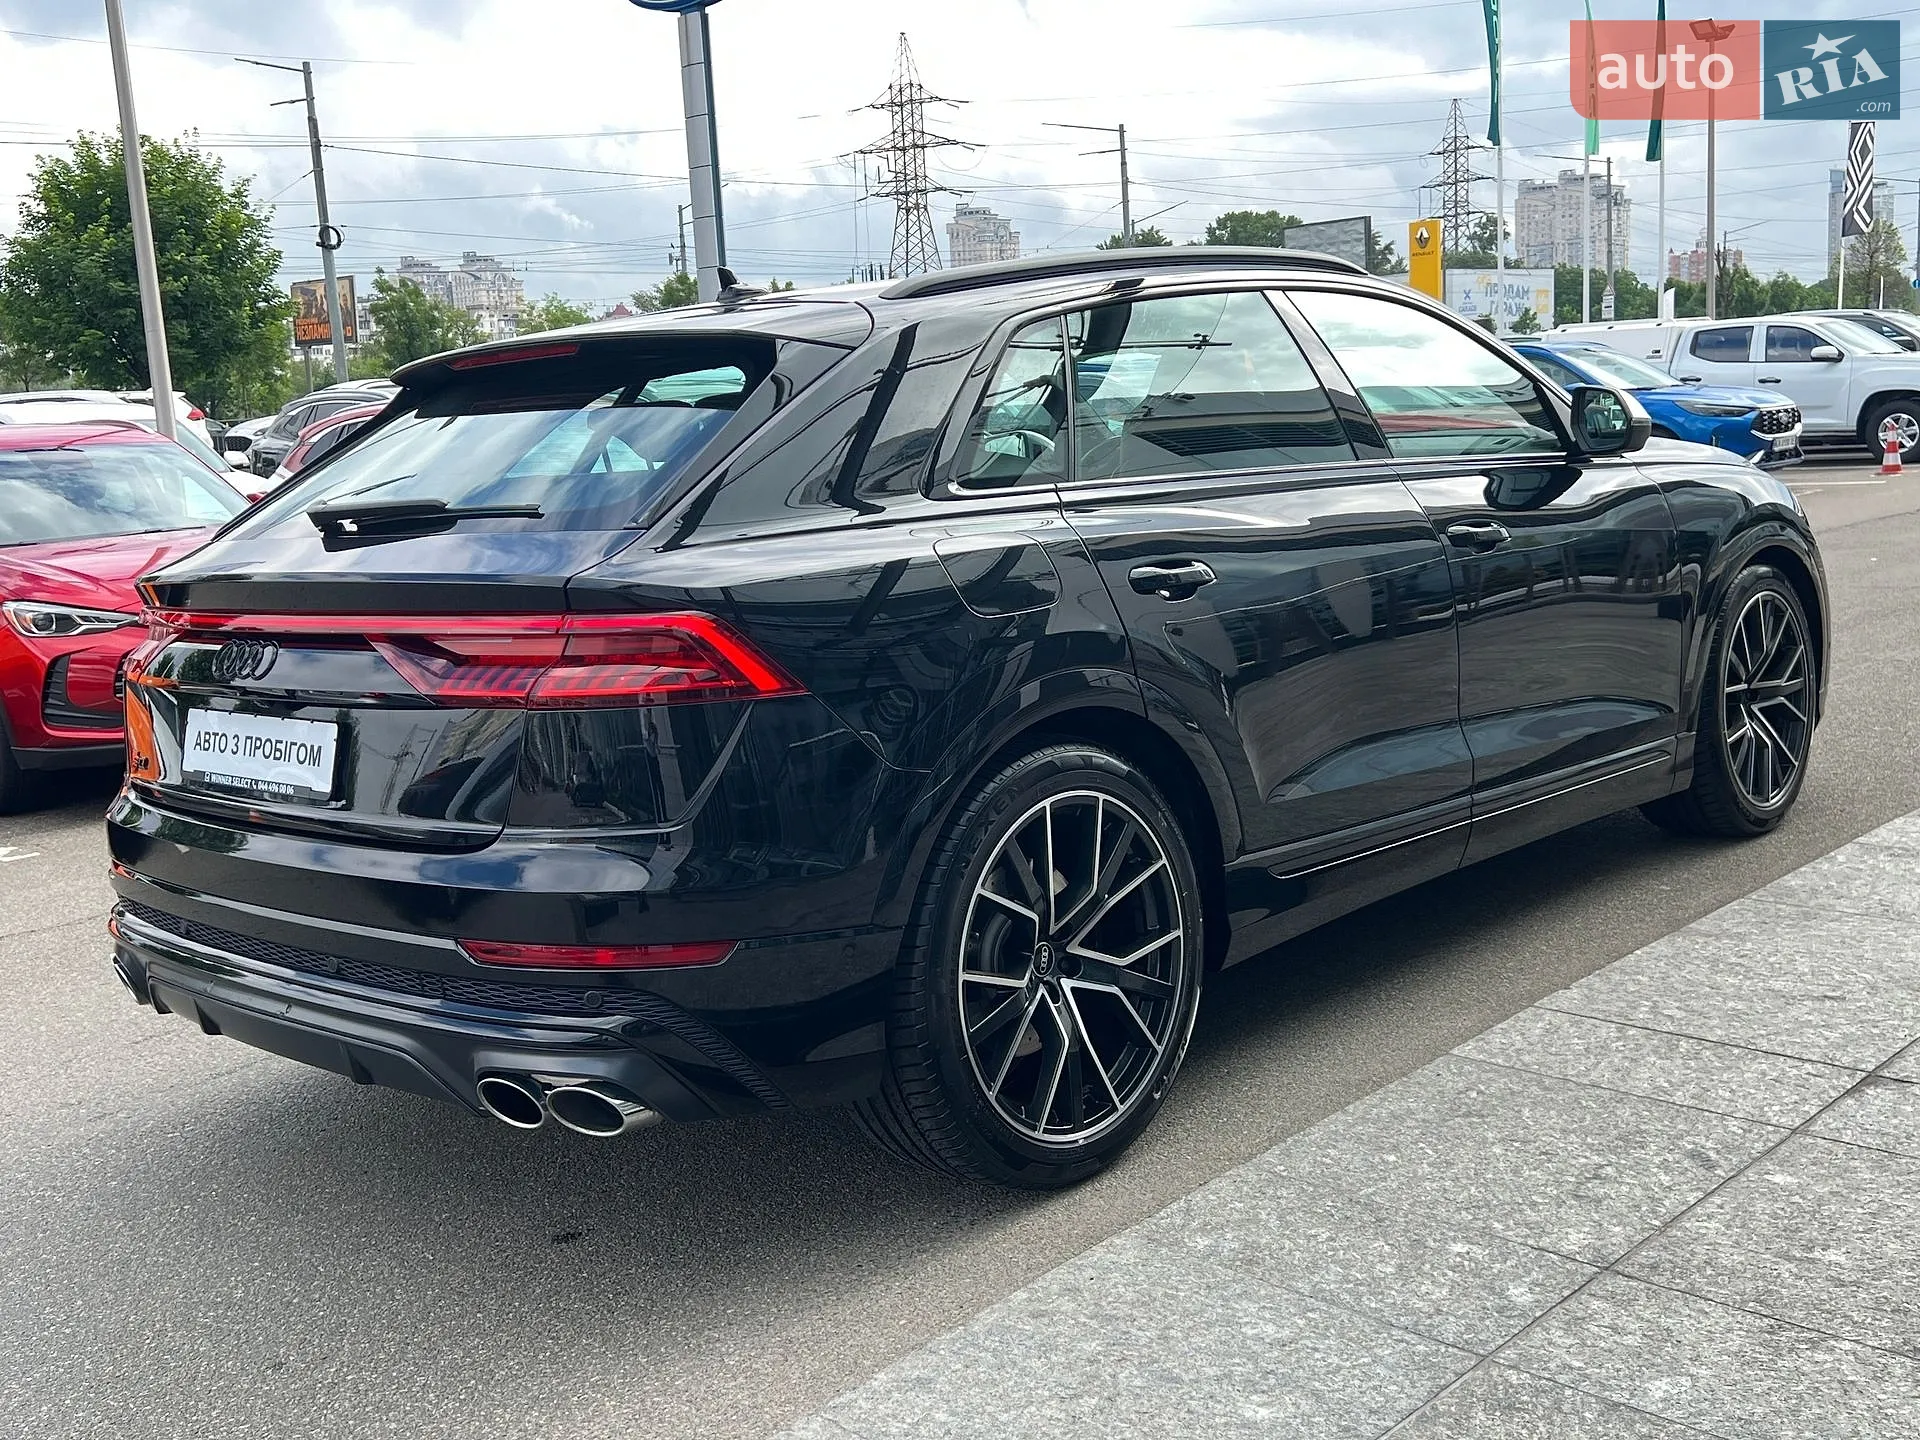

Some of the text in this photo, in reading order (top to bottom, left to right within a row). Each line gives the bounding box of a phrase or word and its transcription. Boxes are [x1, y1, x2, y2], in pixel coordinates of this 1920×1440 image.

[193, 730, 228, 754] АВТО
[243, 735, 322, 767] ПРОБІГОМ
[211, 773, 232, 786] WINNER
[232, 776, 252, 788] SELECT
